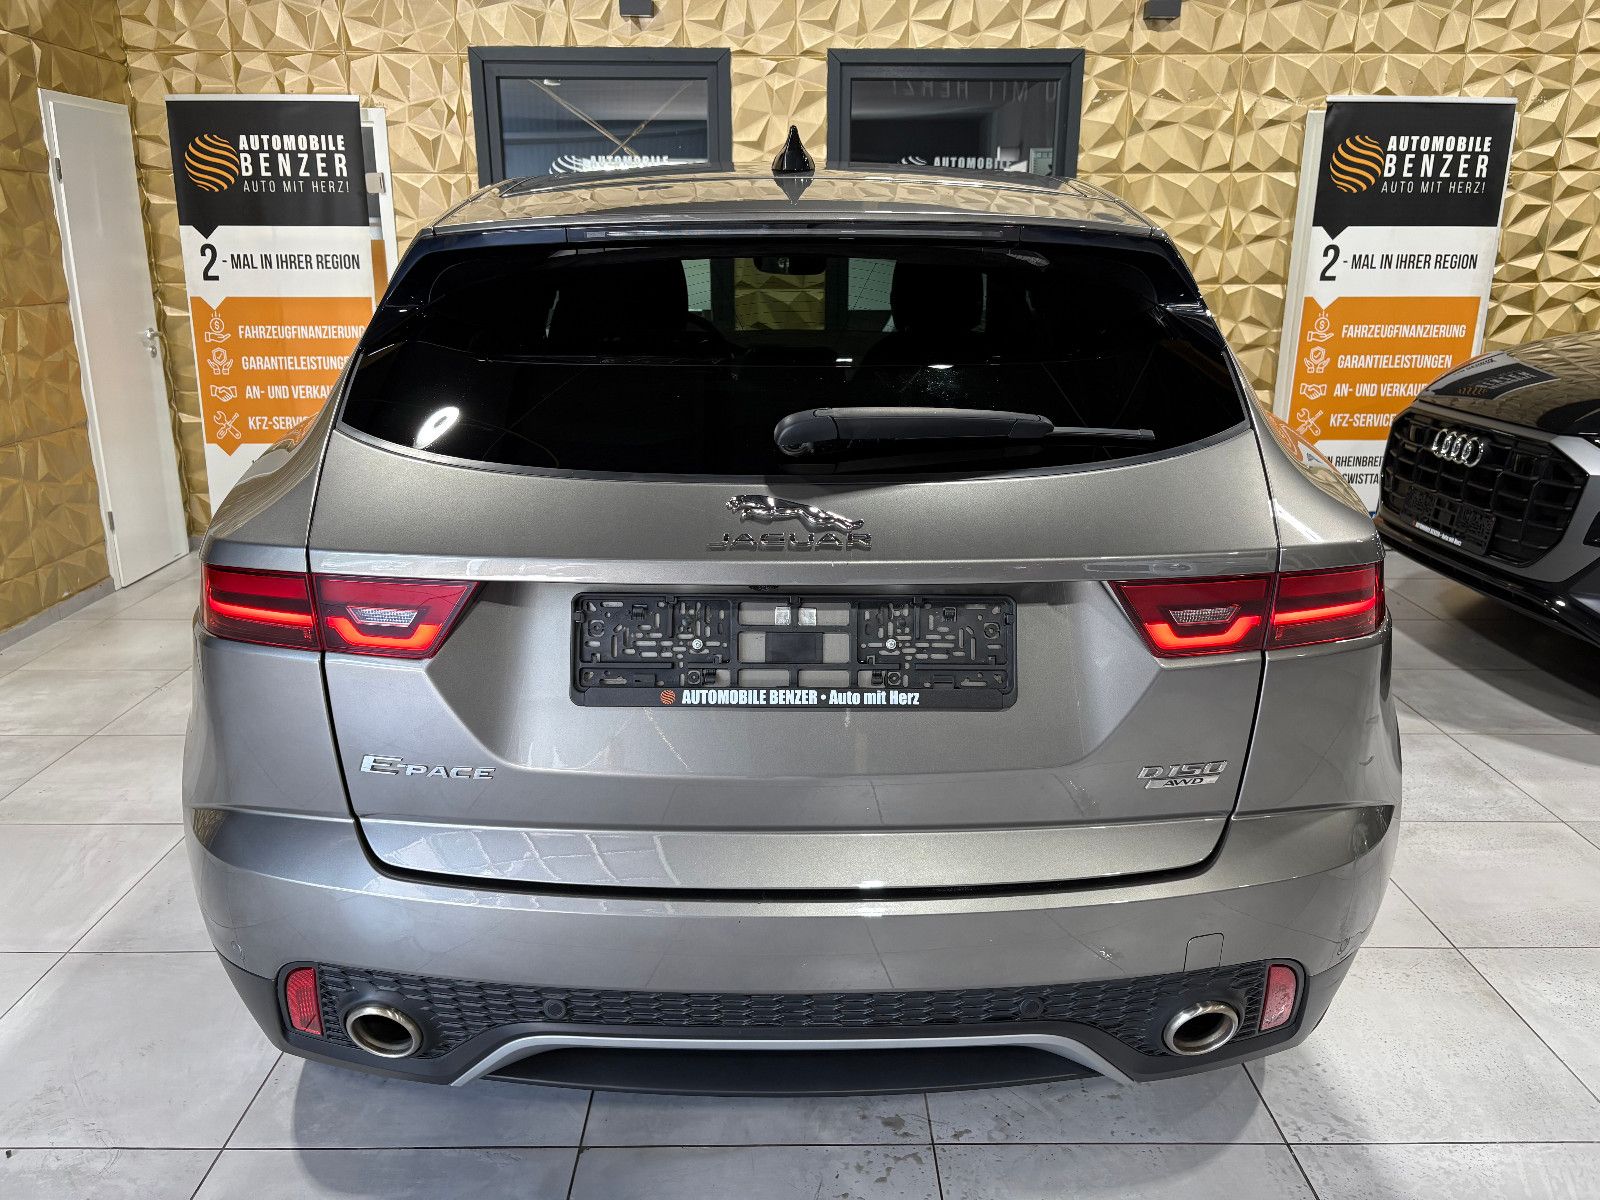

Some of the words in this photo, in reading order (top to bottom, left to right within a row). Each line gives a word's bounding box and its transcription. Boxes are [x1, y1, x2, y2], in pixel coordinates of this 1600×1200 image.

[238, 134, 346, 151] AUTOMOBILE
[1387, 135, 1492, 153] AUTOMOBILE
[240, 153, 348, 177] BENZER
[1383, 154, 1489, 178] BENZER
[243, 181, 276, 193] AUTO
[283, 181, 305, 193] MIT
[312, 181, 350, 193] HERZ!
[1381, 181, 1414, 194] AUTO
[1420, 181, 1443, 194] MIT
[1449, 181, 1486, 194] HERZ!
[200, 243, 220, 281] 2
[230, 253, 258, 270] MAL
[260, 253, 273, 270] IN
[275, 254, 314, 270] IHRER
[316, 254, 361, 270] REGION
[1319, 243, 1341, 282] 2
[1351, 253, 1377, 270] MAL
[1379, 253, 1393, 270] IN
[1395, 254, 1432, 270] IHRER
[1434, 254, 1478, 270] REGION
[1341, 324, 1467, 339] FAHRZEUGFINANZIERUNG
[1337, 354, 1453, 369] GARANTIELEISTUNGEN
[245, 385, 266, 399] AN-
[268, 385, 290, 399] UND
[1333, 383, 1354, 397] AN-
[1355, 383, 1378, 397] UND
[706, 532, 872, 551] JAGUAR
[681, 689, 767, 705] AUTOMOBILE
[769, 690, 818, 705] BENZER
[828, 690, 861, 705] Auto
[863, 690, 887, 705] mit
[889, 690, 920, 705] Herz
[1137, 760, 1228, 780] D150
[1162, 777, 1204, 787] AWD
